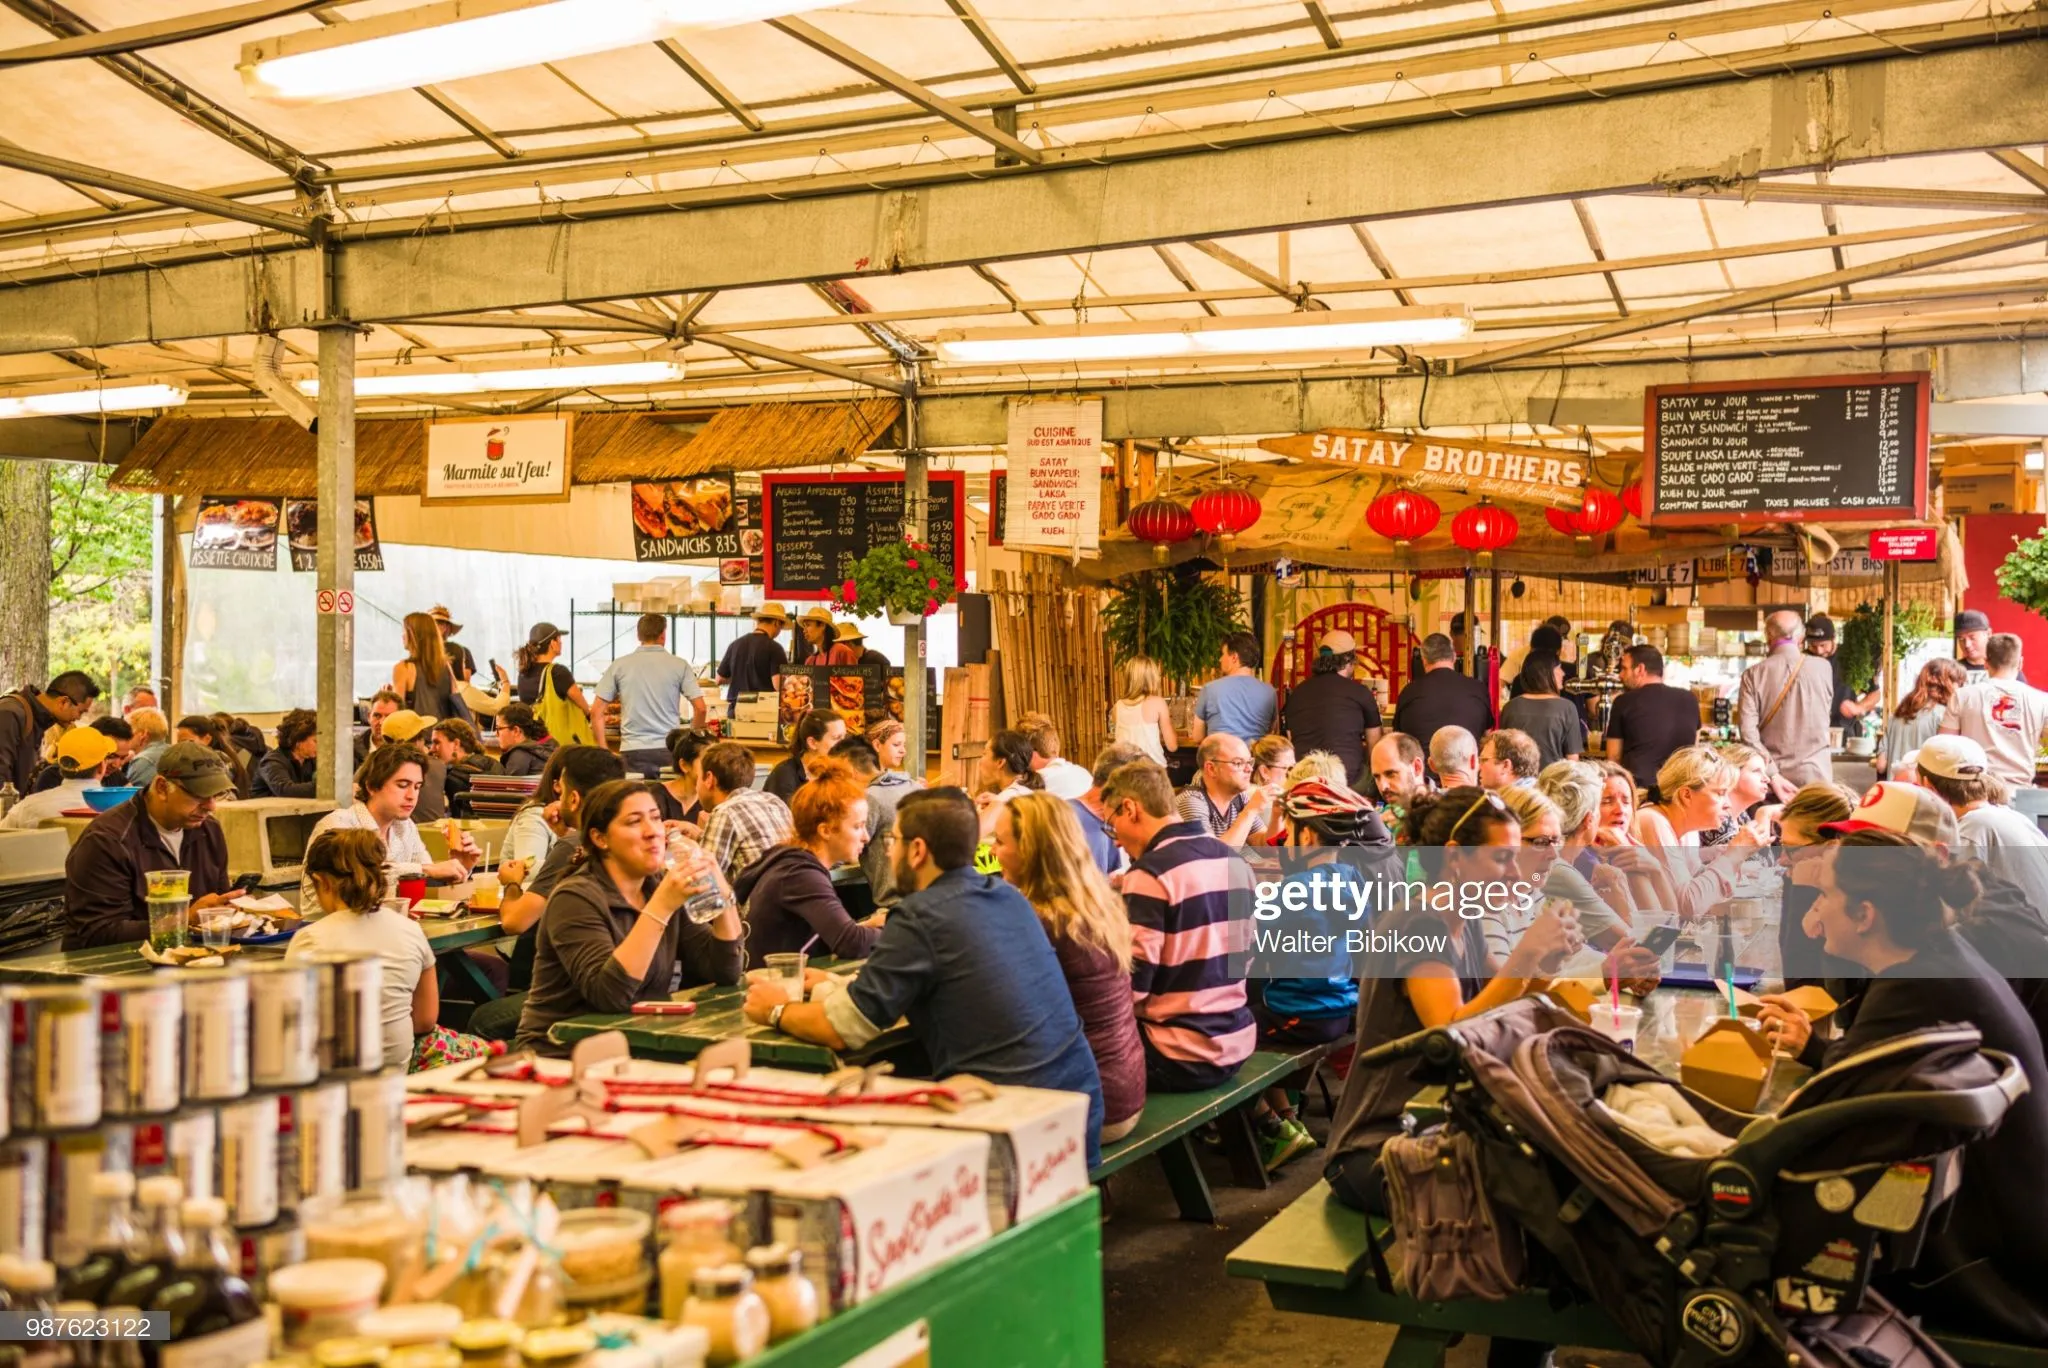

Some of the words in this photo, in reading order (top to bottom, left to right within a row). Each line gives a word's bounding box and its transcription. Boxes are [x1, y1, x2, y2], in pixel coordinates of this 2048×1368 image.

[1661, 398, 1698, 409] SATAY
[1704, 399, 1716, 407] DU
[1723, 396, 1748, 407] JOUR
[1662, 412, 1684, 422] BUN
[1689, 410, 1727, 420] VAPEUR
[1034, 427, 1076, 438] CUISINE
[1660, 424, 1695, 436] SATAY
[1700, 422, 1748, 434] SANDWICH
[1055, 438, 1091, 446] ASIATIQUE
[1661, 436, 1709, 449] SANDWICH
[1712, 437, 1723, 446] DU
[1725, 437, 1748, 446] JOUR
[1311, 434, 1412, 467] SATAY
[1423, 444, 1582, 488] BROTHERS
[1661, 451, 1692, 461] SOUPE
[1695, 450, 1724, 460] LAKSA
[1727, 449, 1763, 460] LEMAK
[1040, 458, 1068, 467] SATAY
[1662, 463, 1694, 473] SALADE
[1704, 462, 1730, 471] PAPAYE
[1732, 461, 1758, 470] VERTE
[443, 463, 497, 481] Marmite
[522, 461, 552, 483] feu!
[1030, 469, 1047, 478] BUN
[1032, 480, 1077, 488] SANDWICH
[1661, 474, 1696, 486] SALADE
[1701, 473, 1725, 484] GADO
[1728, 471, 1754, 483] GADO
[1040, 490, 1066, 498] LAKSA
[1660, 489, 1683, 499] KUEH
[1687, 489, 1699, 498] DU
[1702, 488, 1726, 498] JOUR
[1028, 501, 1056, 510] PAPAYE
[1059, 500, 1086, 511] VERTE
[1660, 500, 1699, 511] COMPTANT
[1702, 500, 1748, 510] SEULEMENT
[1764, 498, 1789, 508] TAXES
[1793, 497, 1830, 507] INCLUSES
[1841, 497, 1864, 505] CASH
[1032, 511, 1055, 520] GADO
[1058, 511, 1080, 520] GADO
[1042, 527, 1064, 535] KUEH
[640, 537, 711, 559] SANDWICHS
[191, 550, 230, 567] ASSIETTE
[232, 551, 261, 567] CHOIX
[262, 552, 275, 568] DE
